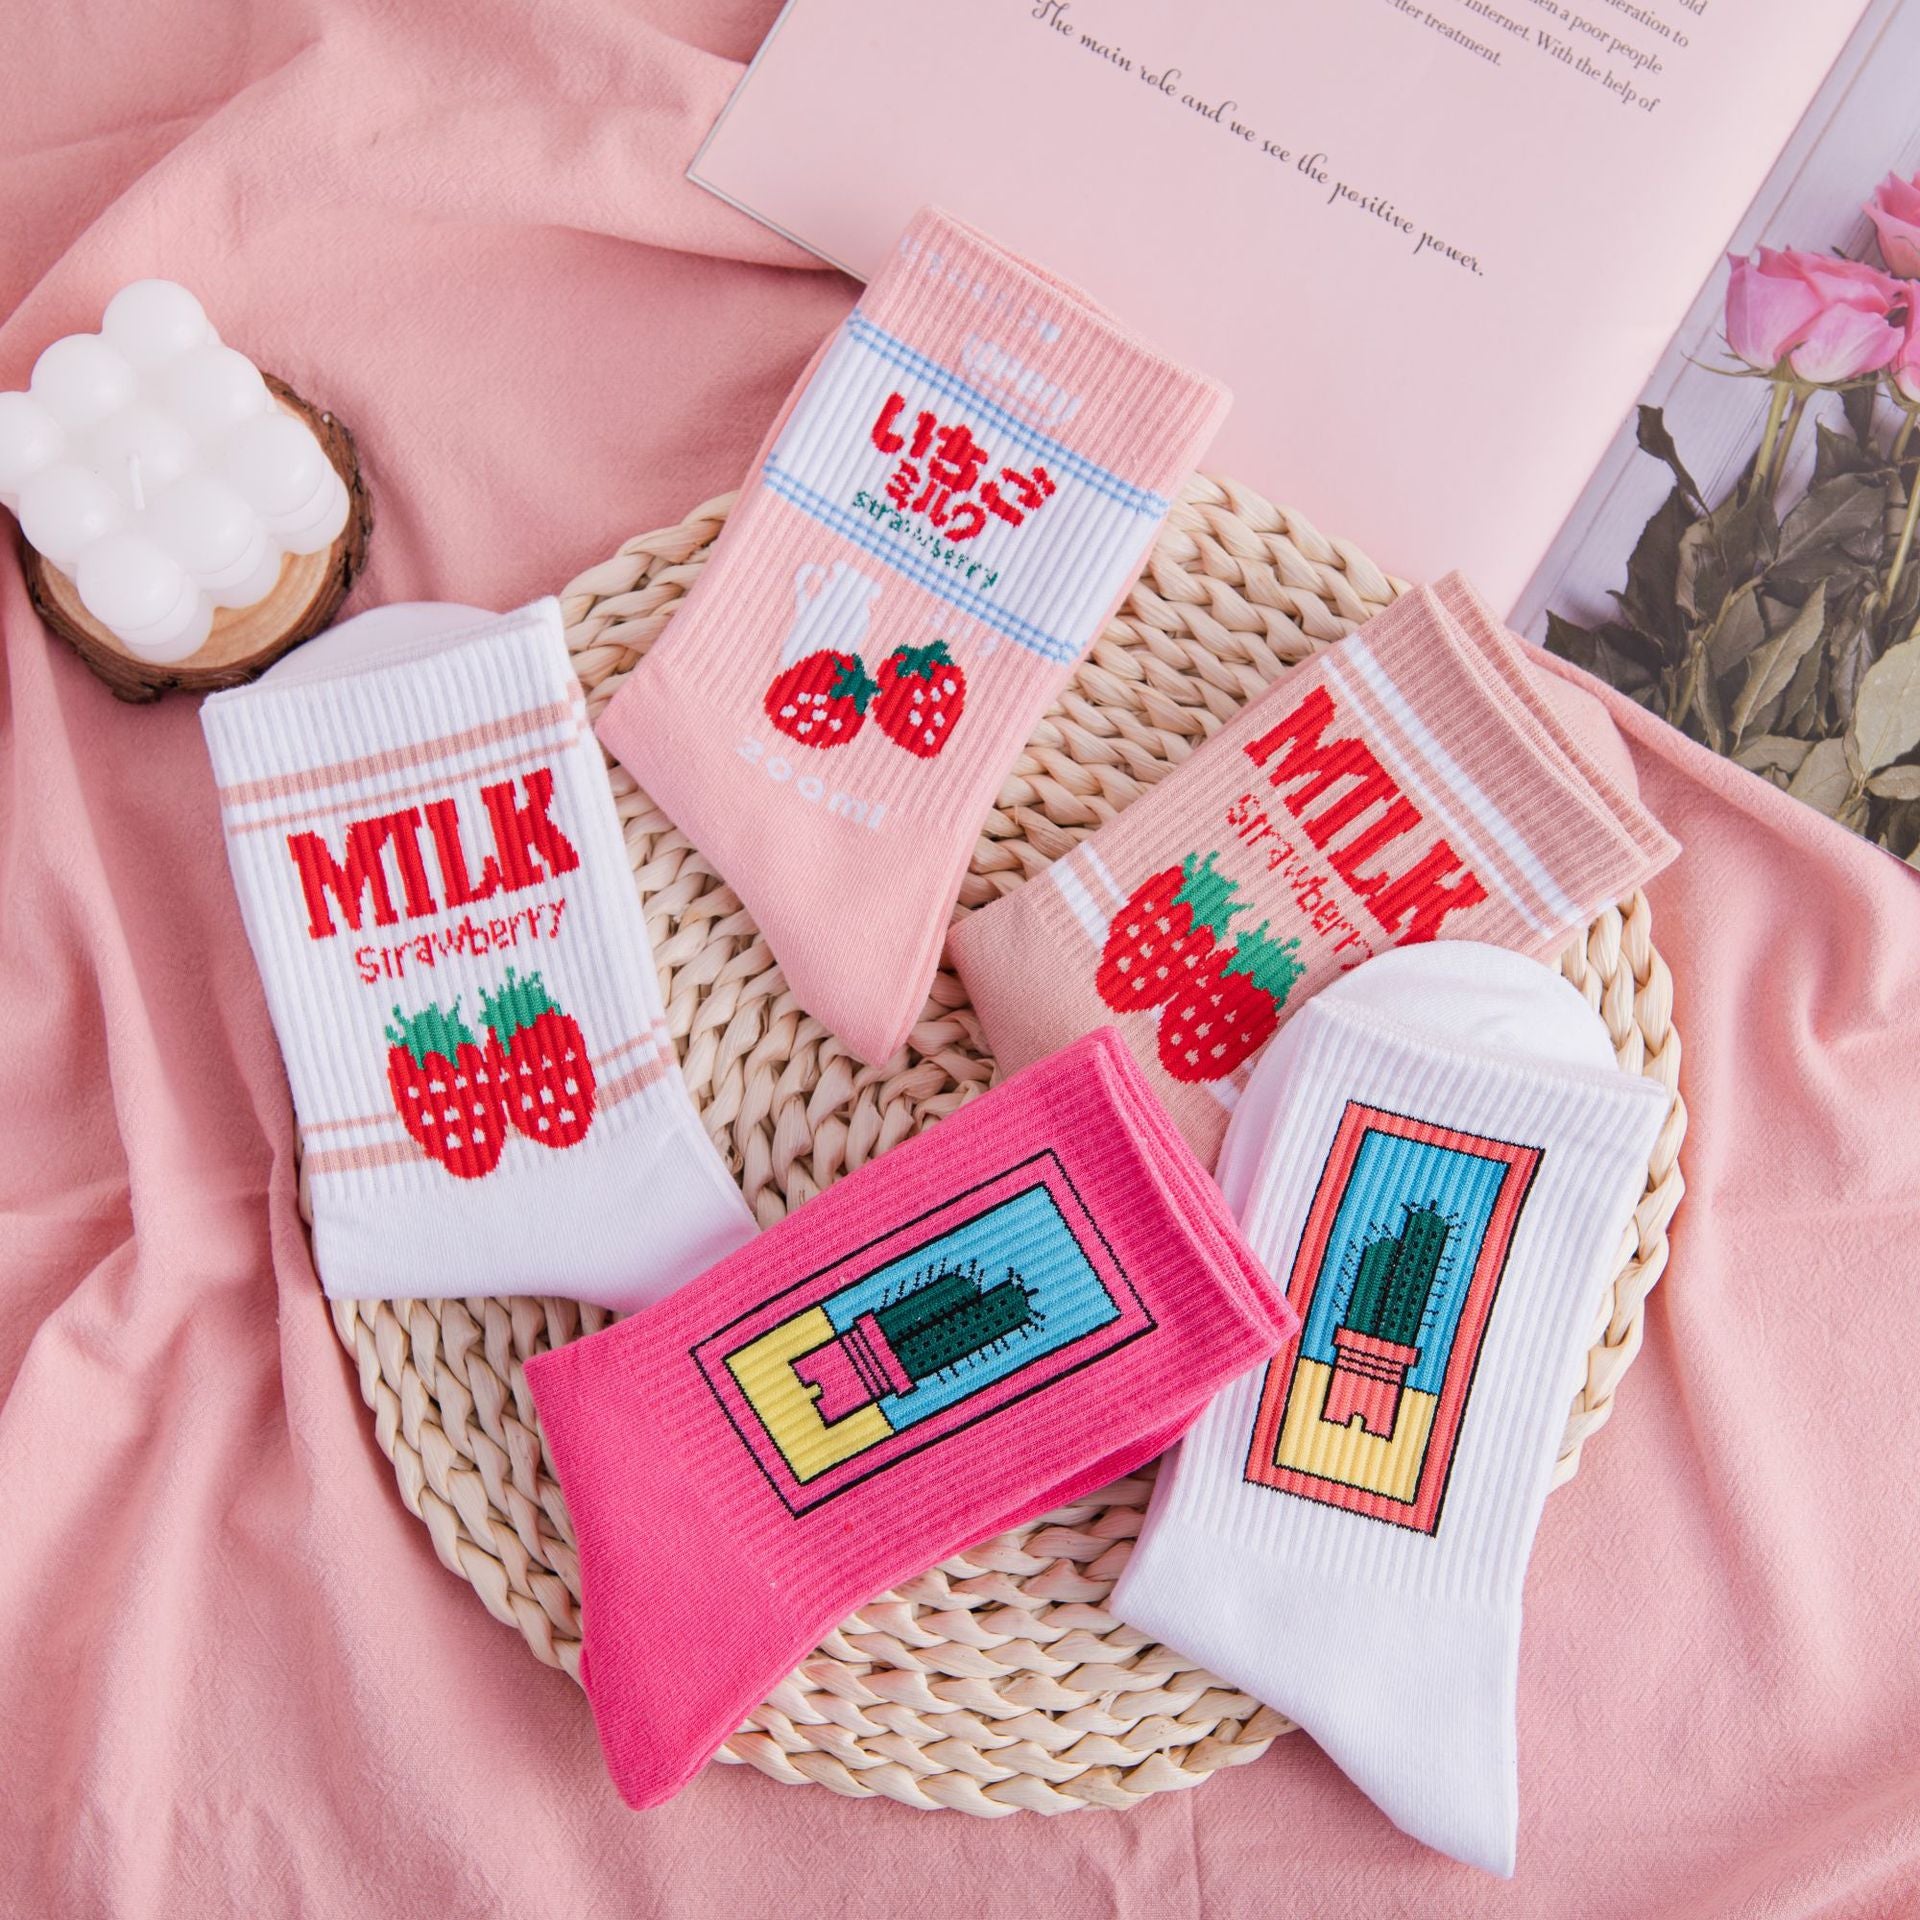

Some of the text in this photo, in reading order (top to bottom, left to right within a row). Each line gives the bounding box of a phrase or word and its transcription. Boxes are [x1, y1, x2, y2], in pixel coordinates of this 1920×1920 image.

[1424, 13, 1502, 67] treatment.
[1537, 30, 1573, 65] With
[1575, 57, 1602, 80] the
[1602, 70, 1637, 105] help
[1638, 98, 1661, 113] of
[1559, 9, 1570, 22] a
[1568, 15, 1610, 43] poor
[1607, 37, 1663, 75] people
[1672, 28, 1690, 48] to
[1031, 0, 1485, 277] The main role and we see the positive power.
[286, 767, 580, 940] MILK
[1243, 685, 1489, 946] MILK
